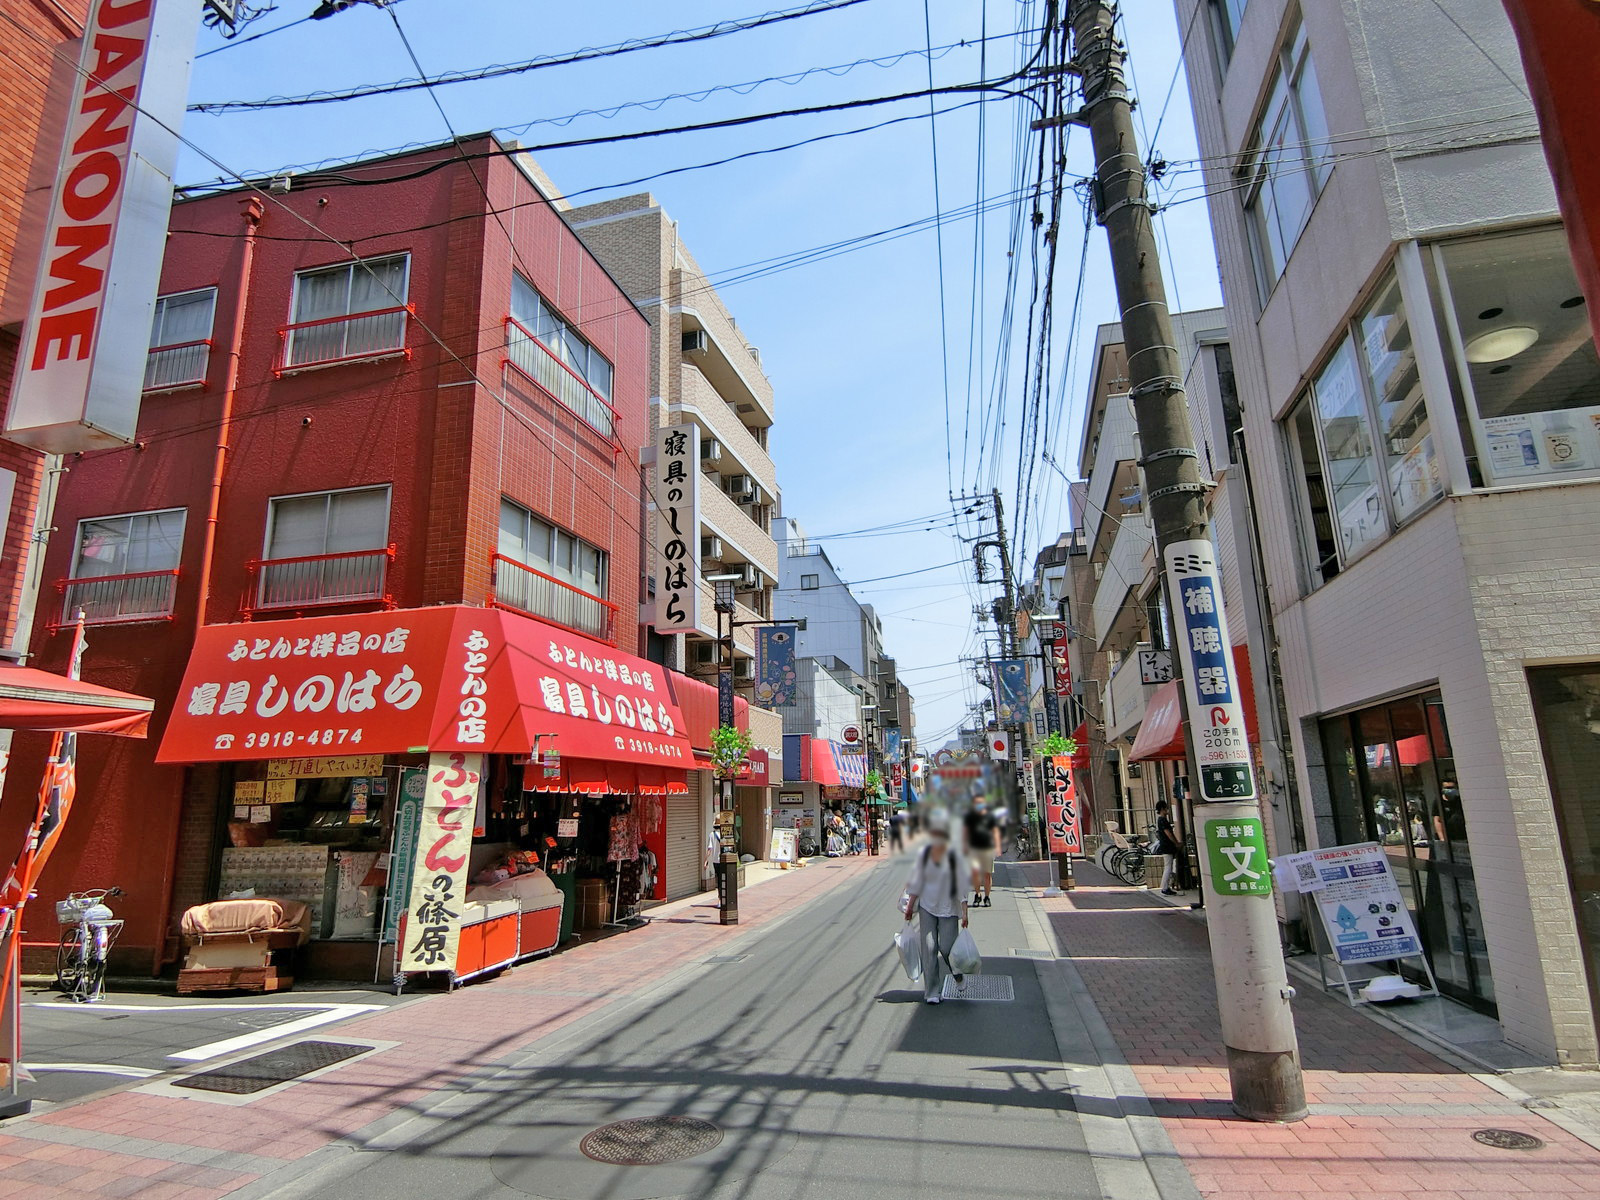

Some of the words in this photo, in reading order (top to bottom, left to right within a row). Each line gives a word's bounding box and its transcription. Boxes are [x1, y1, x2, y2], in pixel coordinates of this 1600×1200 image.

[663, 430, 688, 625] 寝具のしのはら
[228, 627, 411, 661] ふとんと洋品の店
[1184, 586, 1228, 695] 補聴器
[548, 640, 655, 693] ふとんと洋品の店
[1145, 652, 1174, 680] そば
[188, 664, 423, 718] 寝具しのはら
[456, 630, 489, 743] ふとんの店
[538, 675, 675, 737] 寝具しのはら
[244, 728, 363, 748] 3918-4874
[629, 737, 682, 759] 3918-4874
[1202, 727, 1239, 738] この手前
[1205, 737, 1241, 748] 200m
[288, 757, 368, 775] 打直しやっています
[1216, 784, 1246, 794] 4-21
[1216, 825, 1254, 838] 通学路
[411, 752, 480, 965] ふとんの篠原
[1220, 841, 1260, 880] 文
